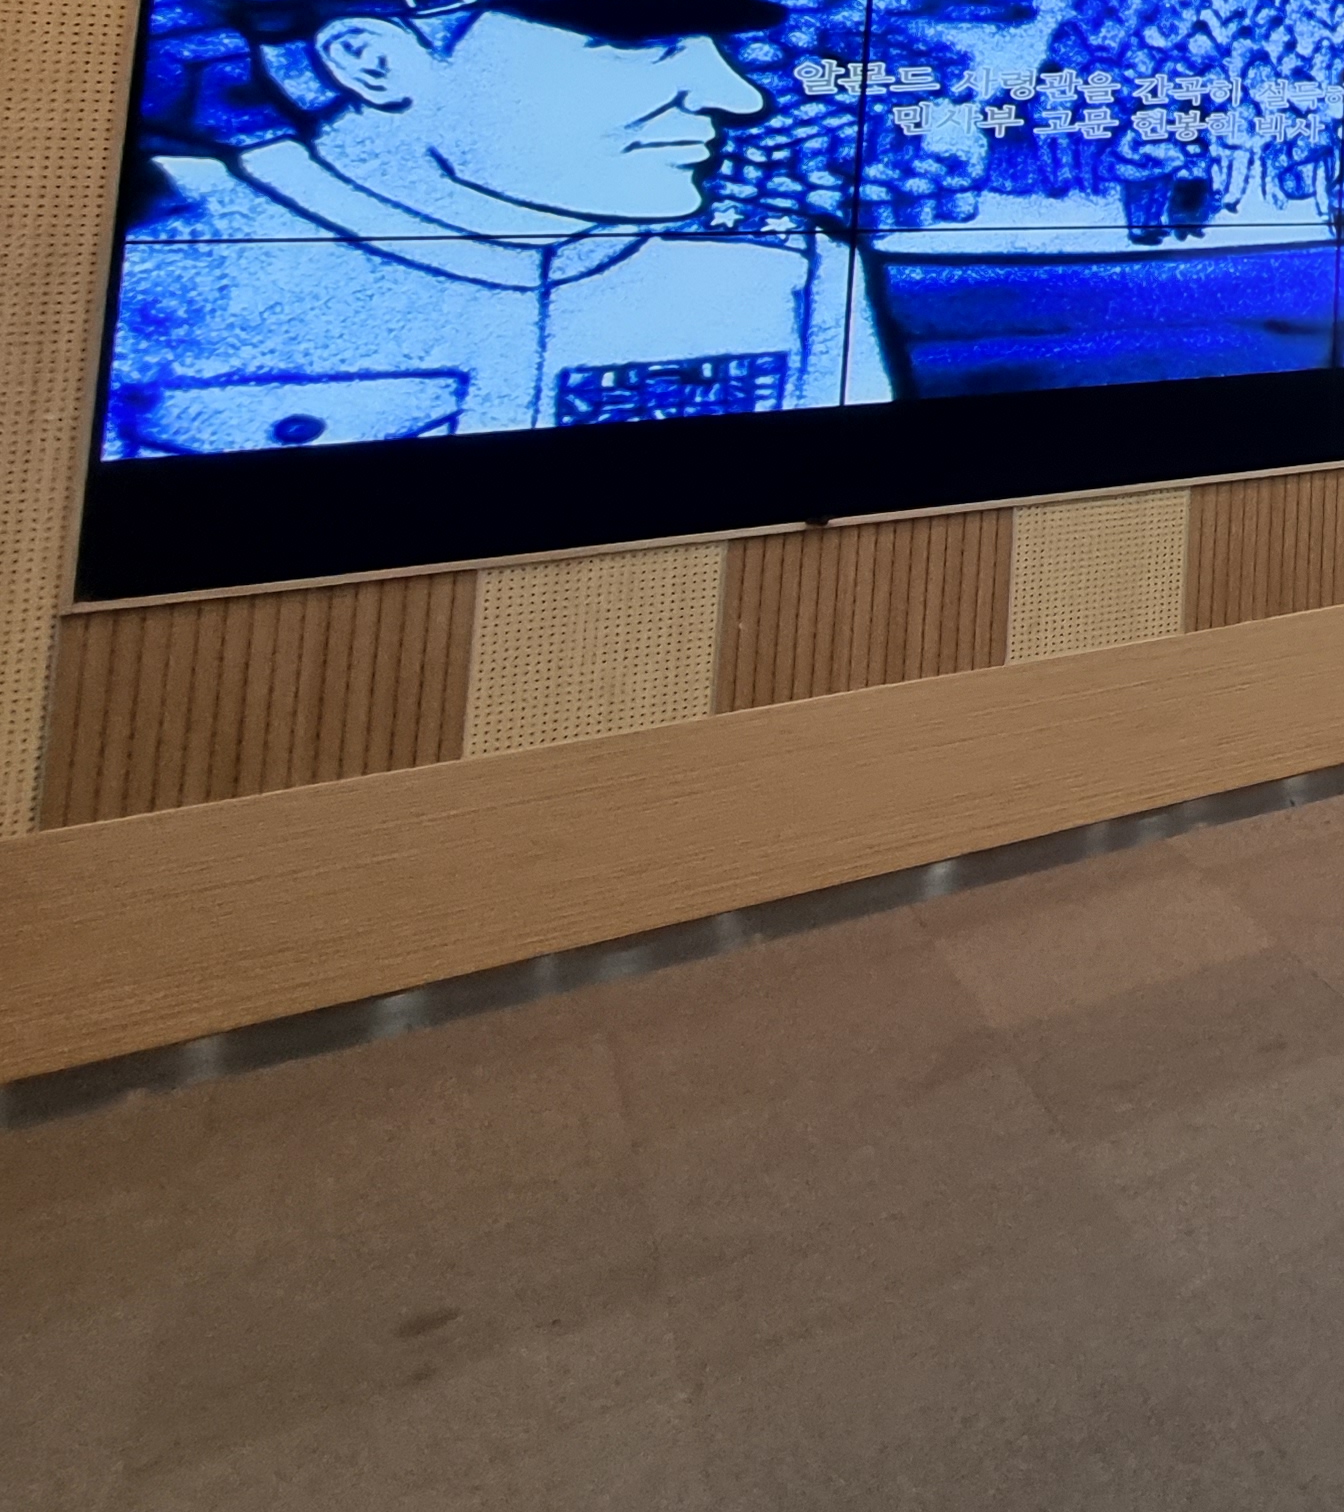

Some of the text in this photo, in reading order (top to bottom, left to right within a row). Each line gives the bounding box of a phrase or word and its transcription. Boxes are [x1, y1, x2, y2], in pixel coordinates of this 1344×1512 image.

[952, 66, 1121, 103] 사령관을
[1132, 73, 1242, 106] 간곡히
[893, 101, 1326, 144] 민사부 고문 현봉학 박사
